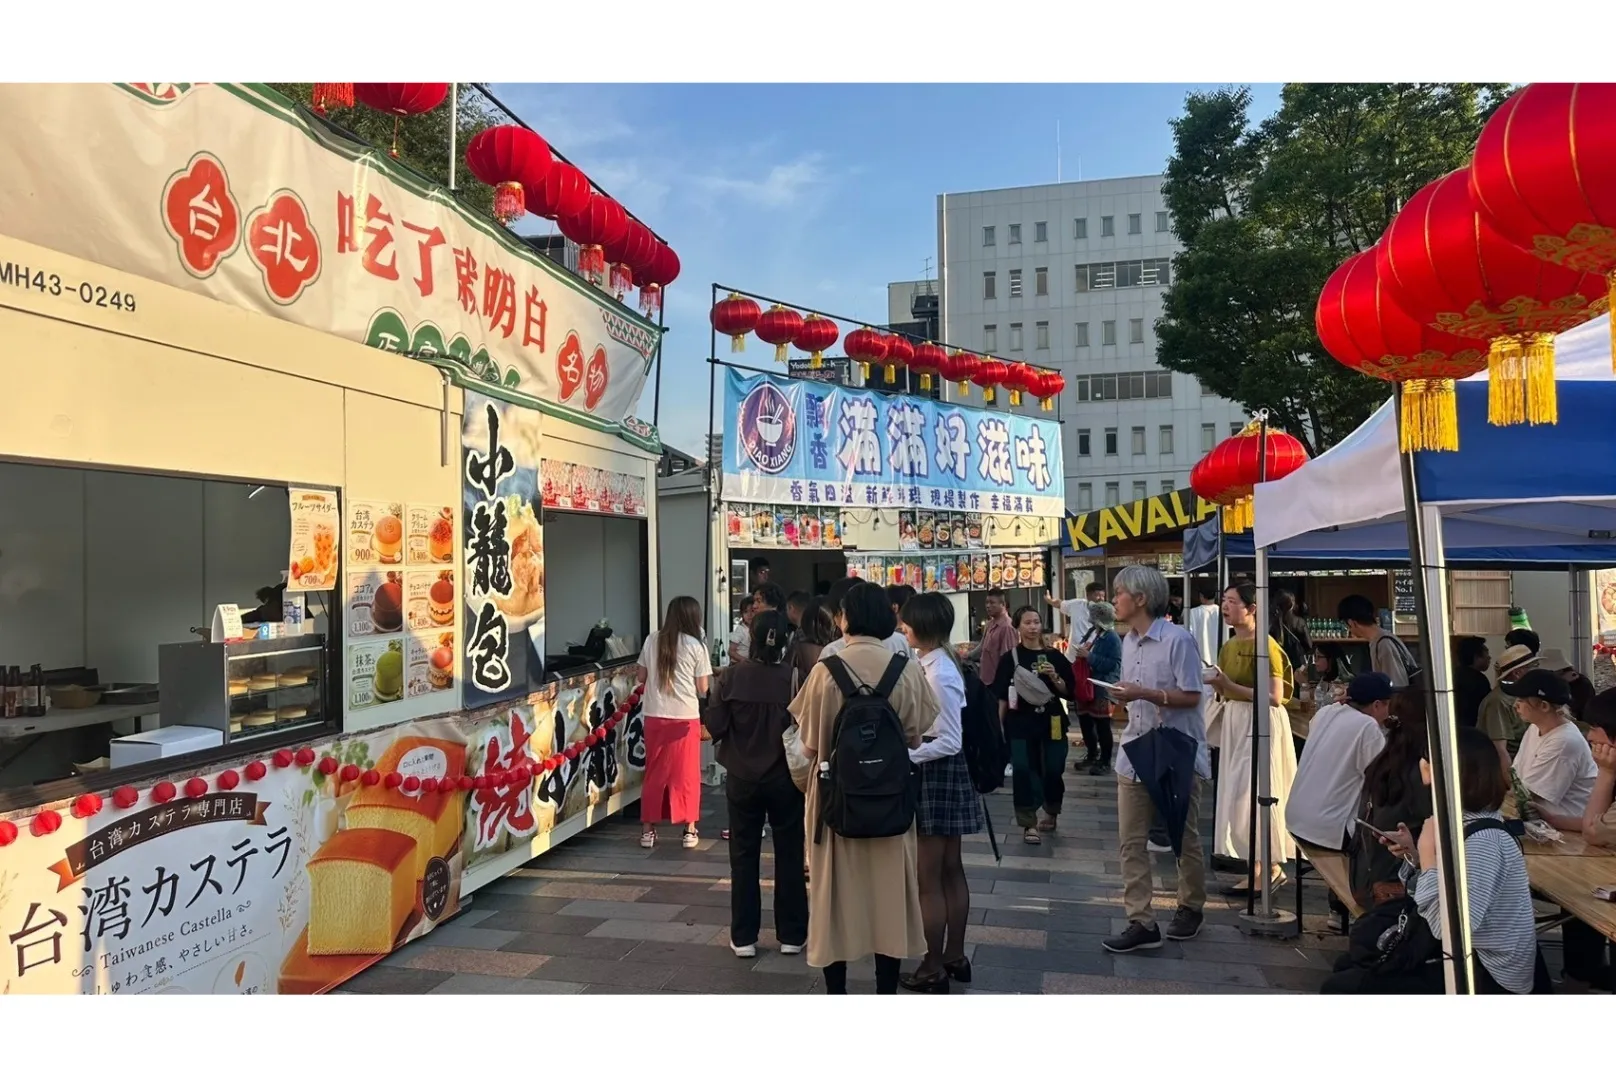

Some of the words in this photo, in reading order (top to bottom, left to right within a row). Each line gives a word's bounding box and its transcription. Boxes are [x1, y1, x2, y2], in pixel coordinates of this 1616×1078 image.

[188, 183, 309, 271] 台北
[0, 262, 136, 312] MH43-0249
[561, 350, 604, 392] 名物
[769, 443, 792, 467] XIANG
[350, 521, 374, 529] カステラ
[355, 510, 370, 520] 台湾
[466, 402, 514, 690] 小籠包
[89, 797, 244, 860] 台湾カステラ専門店
[8, 826, 292, 976] 台湾カステラ
[100, 929, 175, 969] Taiwanese
[180, 908, 233, 936] Castella
